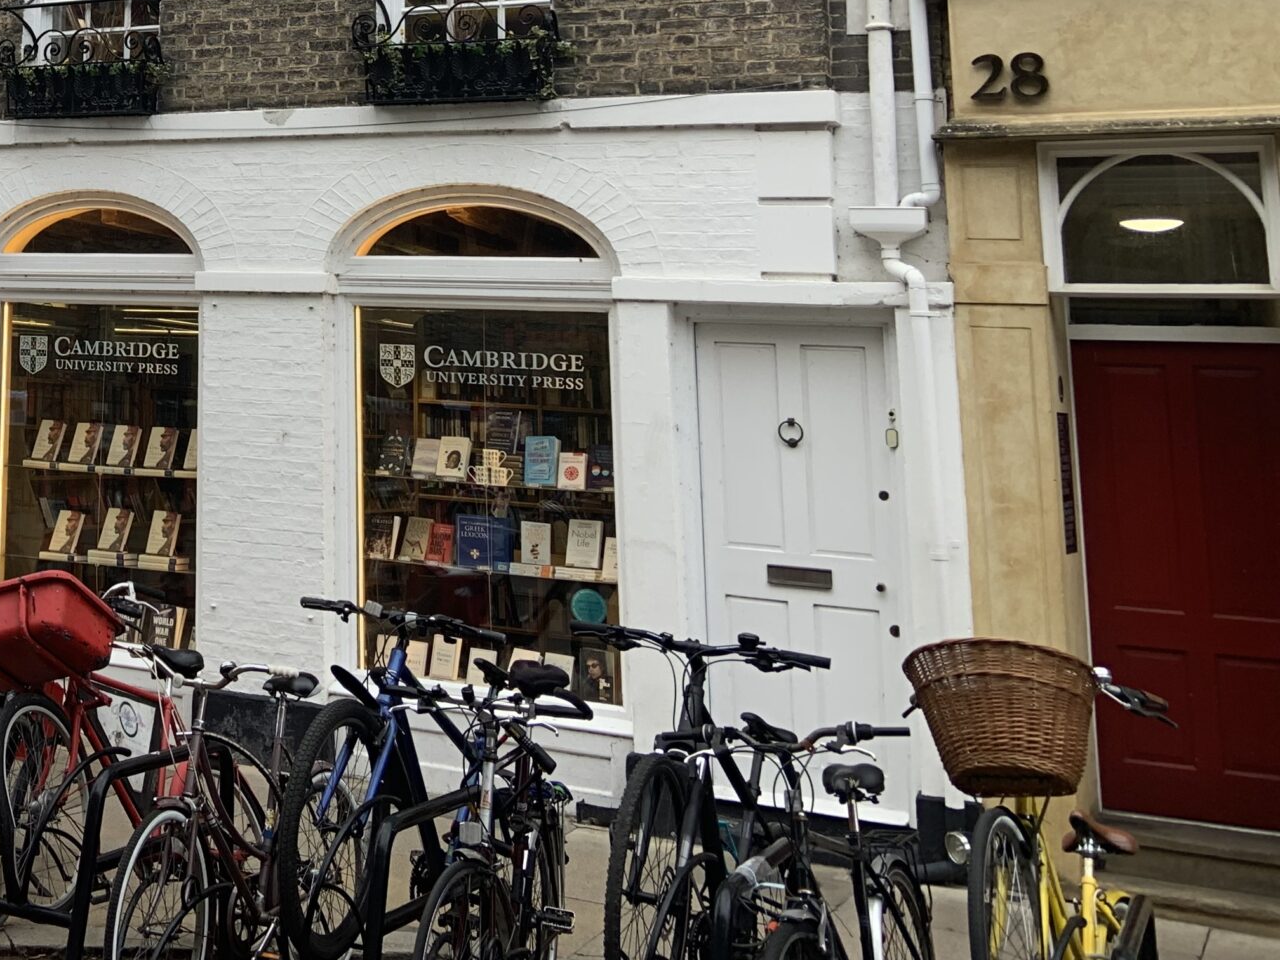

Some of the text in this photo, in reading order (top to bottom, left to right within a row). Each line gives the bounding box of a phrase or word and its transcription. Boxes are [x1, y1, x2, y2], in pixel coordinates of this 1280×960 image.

[971, 52, 1049, 102] 28
[54, 336, 180, 360] CAMBRIDGE
[423, 345, 585, 373] CAMBRIDGE
[55, 359, 179, 376] UNIVERSITY PRESS
[425, 371, 585, 391] UNIVERSITY PRESS
[461, 531, 489, 539] LEXICON
[464, 525, 486, 533] GREEK
[571, 529, 597, 539] Nobel
[576, 538, 591, 548] Life
[153, 615, 174, 627] WORLD
[155, 626, 169, 637] WAR
